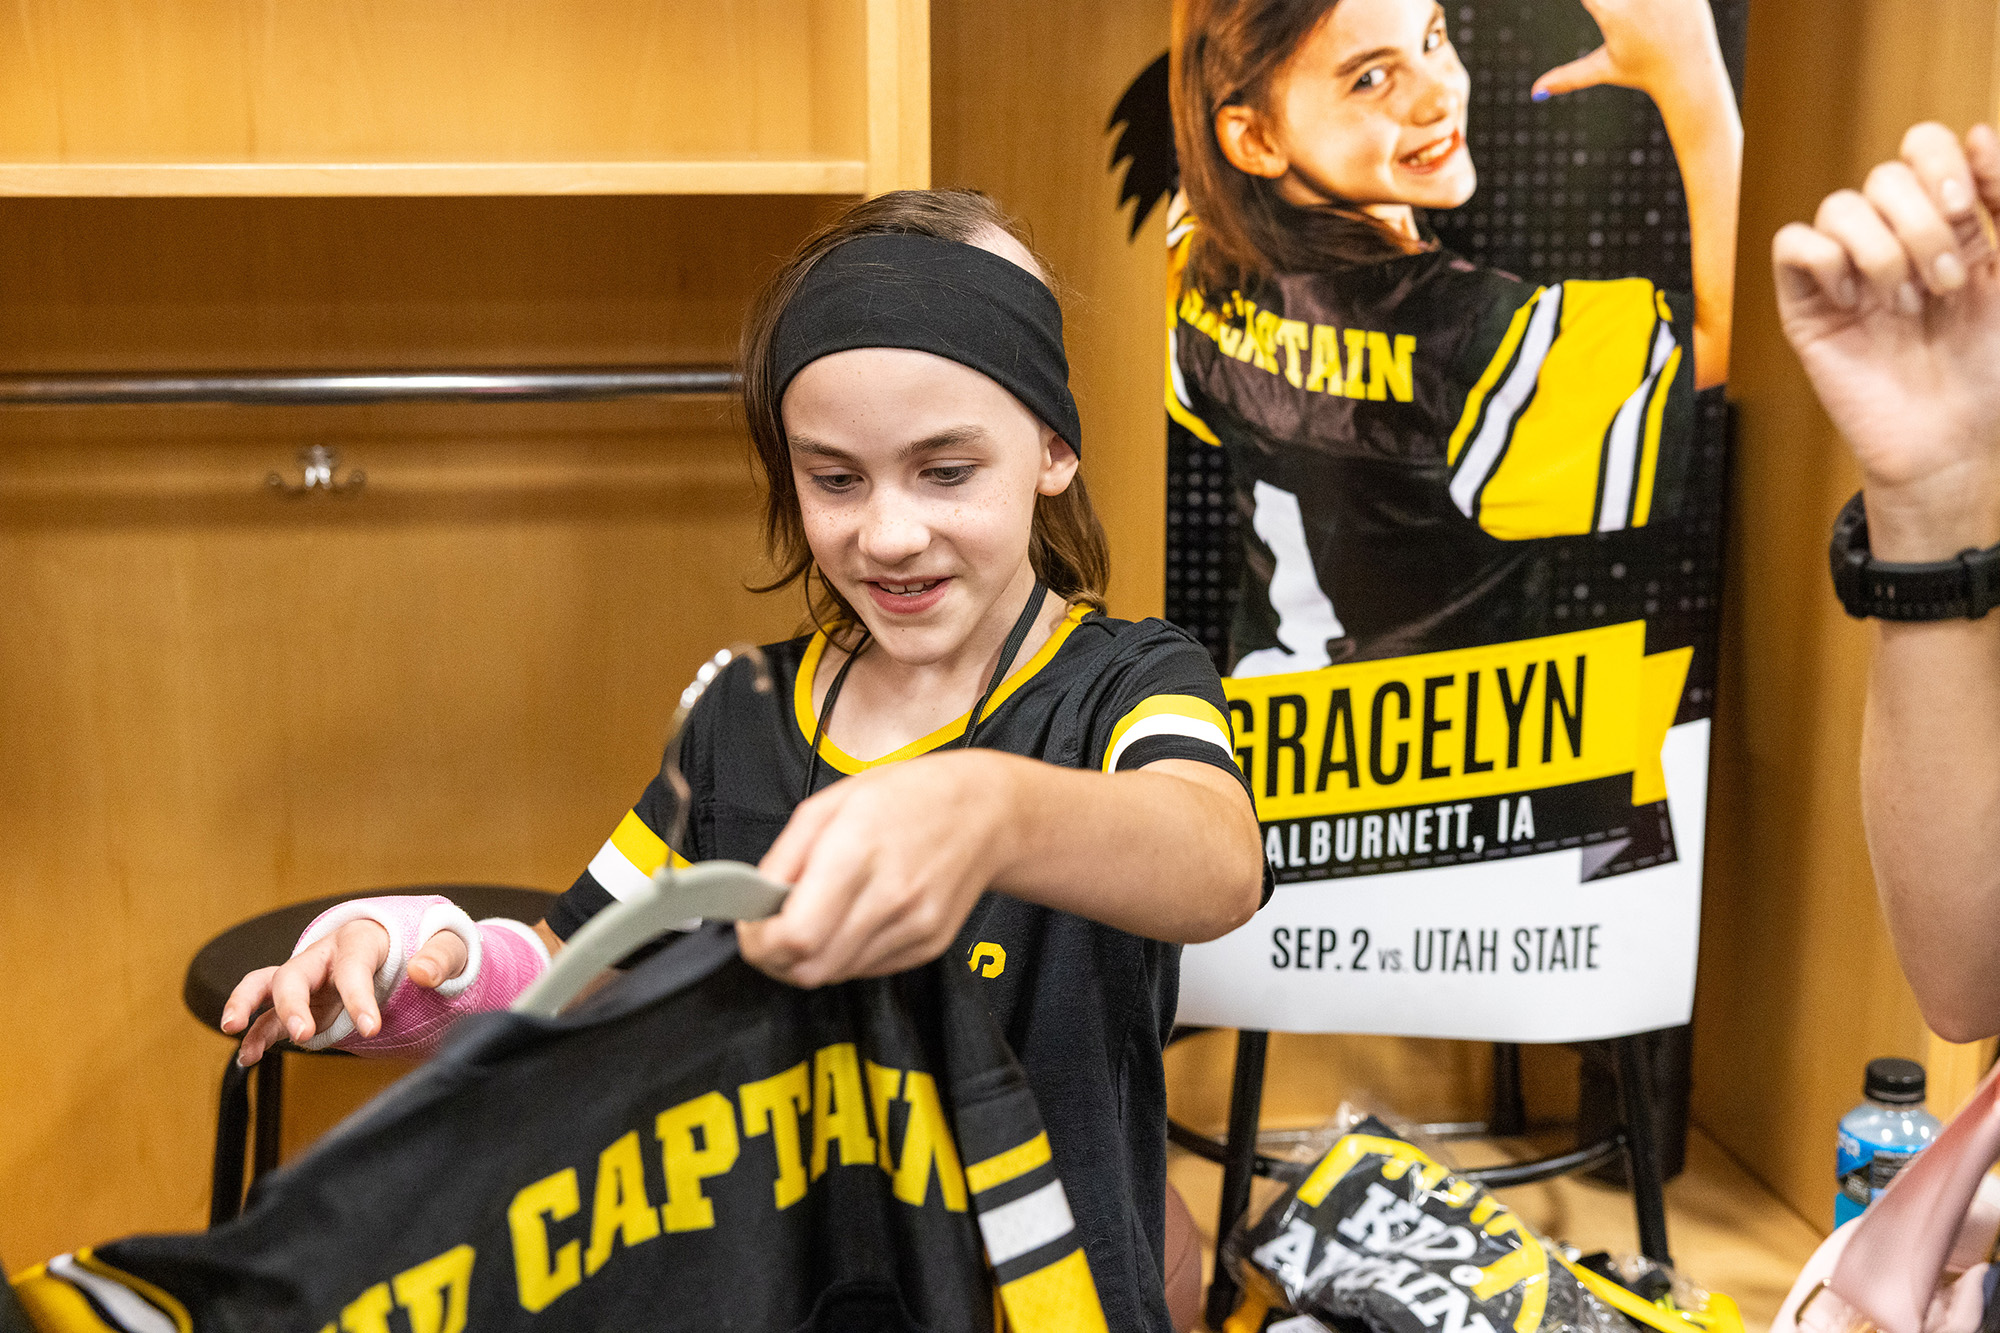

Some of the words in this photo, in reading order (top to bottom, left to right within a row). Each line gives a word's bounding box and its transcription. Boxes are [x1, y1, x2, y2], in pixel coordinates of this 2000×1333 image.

[1266, 803, 1485, 870] ALBURNETT,
[1498, 796, 1536, 843] IA
[1272, 926, 1342, 970] SEP.
[1350, 928, 1370, 971] 2
[1413, 928, 1498, 973] UTAH
[1512, 924, 1601, 973] STATE
[508, 1042, 968, 1313] CAPTAIN
